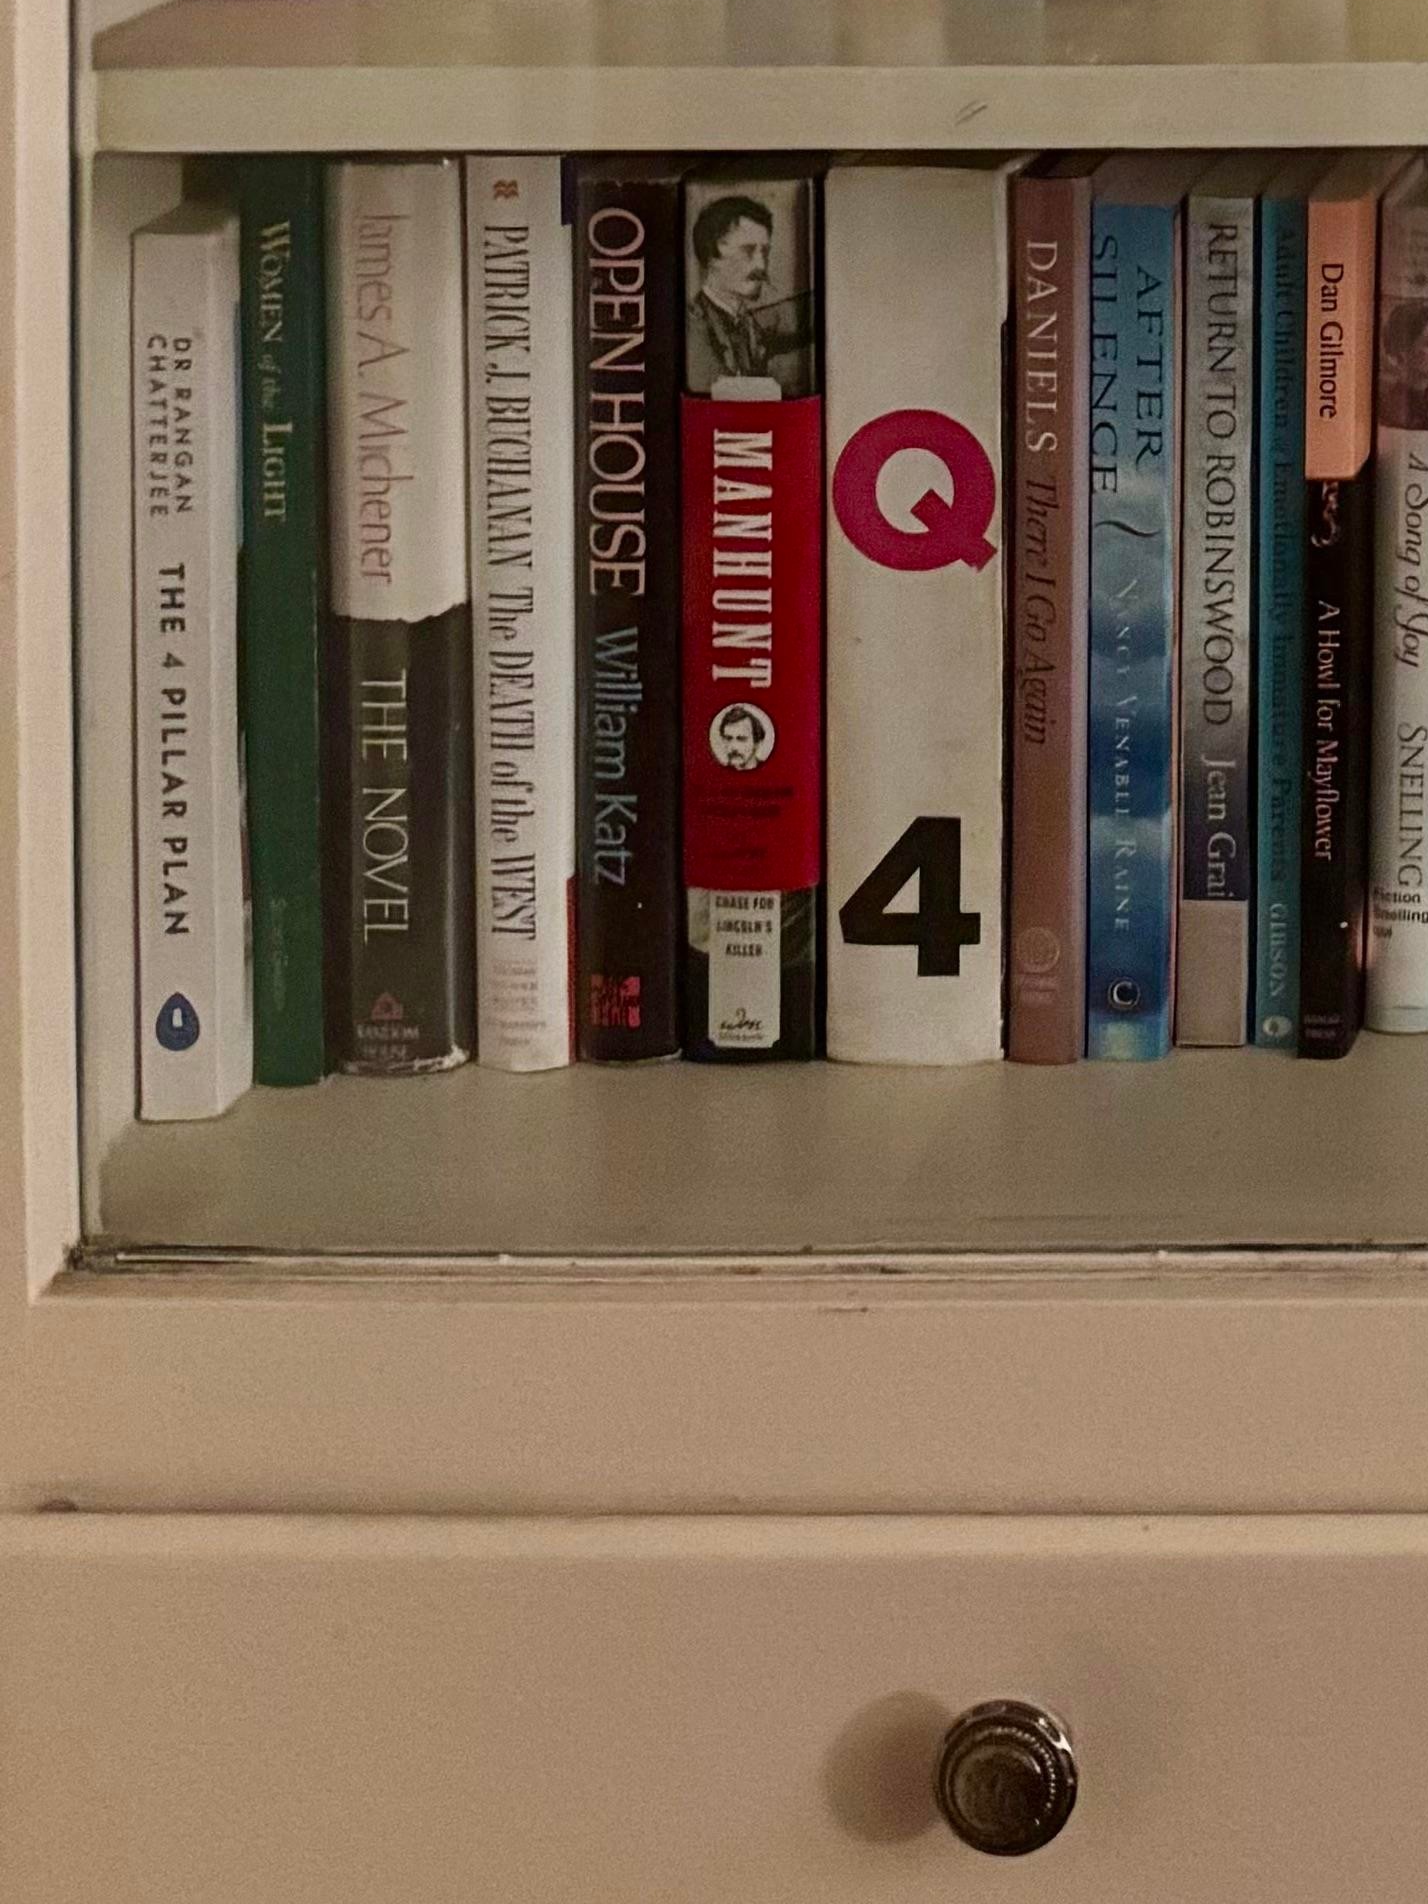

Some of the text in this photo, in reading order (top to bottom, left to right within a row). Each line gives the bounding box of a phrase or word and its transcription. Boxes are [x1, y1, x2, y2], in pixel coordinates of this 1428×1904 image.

[149, 335, 172, 518] CHATTERJEE
[173, 337, 196, 514] DR RANGAN
[586, 206, 648, 598] OPEN HOUSE
[1090, 232, 1119, 498] SILENCE
[1134, 265, 1166, 468] AFTER
[1318, 263, 1346, 420] Dan Gilmore
[710, 426, 775, 691] MANHUNT
[832, 409, 998, 573] Q
[159, 563, 190, 937] THE 4 PILLAR PLAN
[361, 670, 410, 946] THE NOVEL
[836, 816, 981, 978] 4
